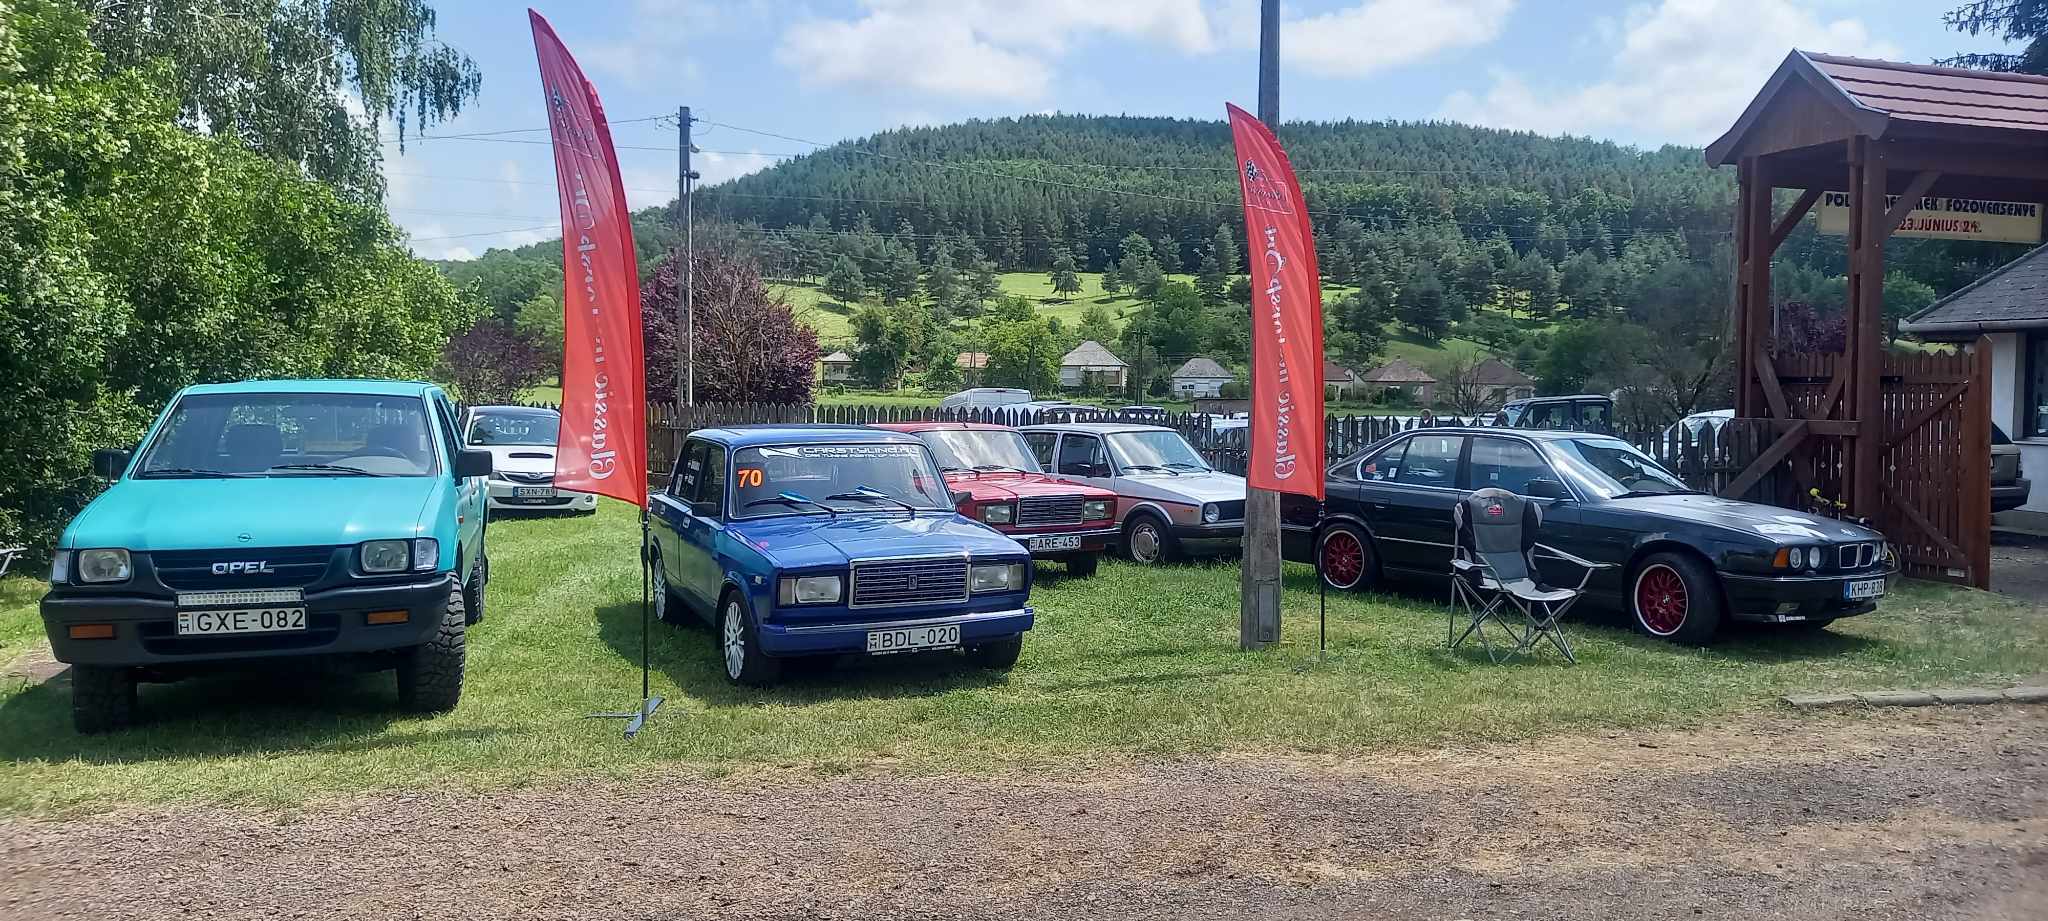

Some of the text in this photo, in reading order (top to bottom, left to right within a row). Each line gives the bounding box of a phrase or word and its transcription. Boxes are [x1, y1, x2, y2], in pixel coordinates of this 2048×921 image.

[737, 469, 762, 488] 70
[1037, 536, 1080, 550] ARE-453
[211, 560, 275, 575] OPEL
[197, 609, 304, 631] GXE-082
[882, 626, 958, 648] BDL-020
